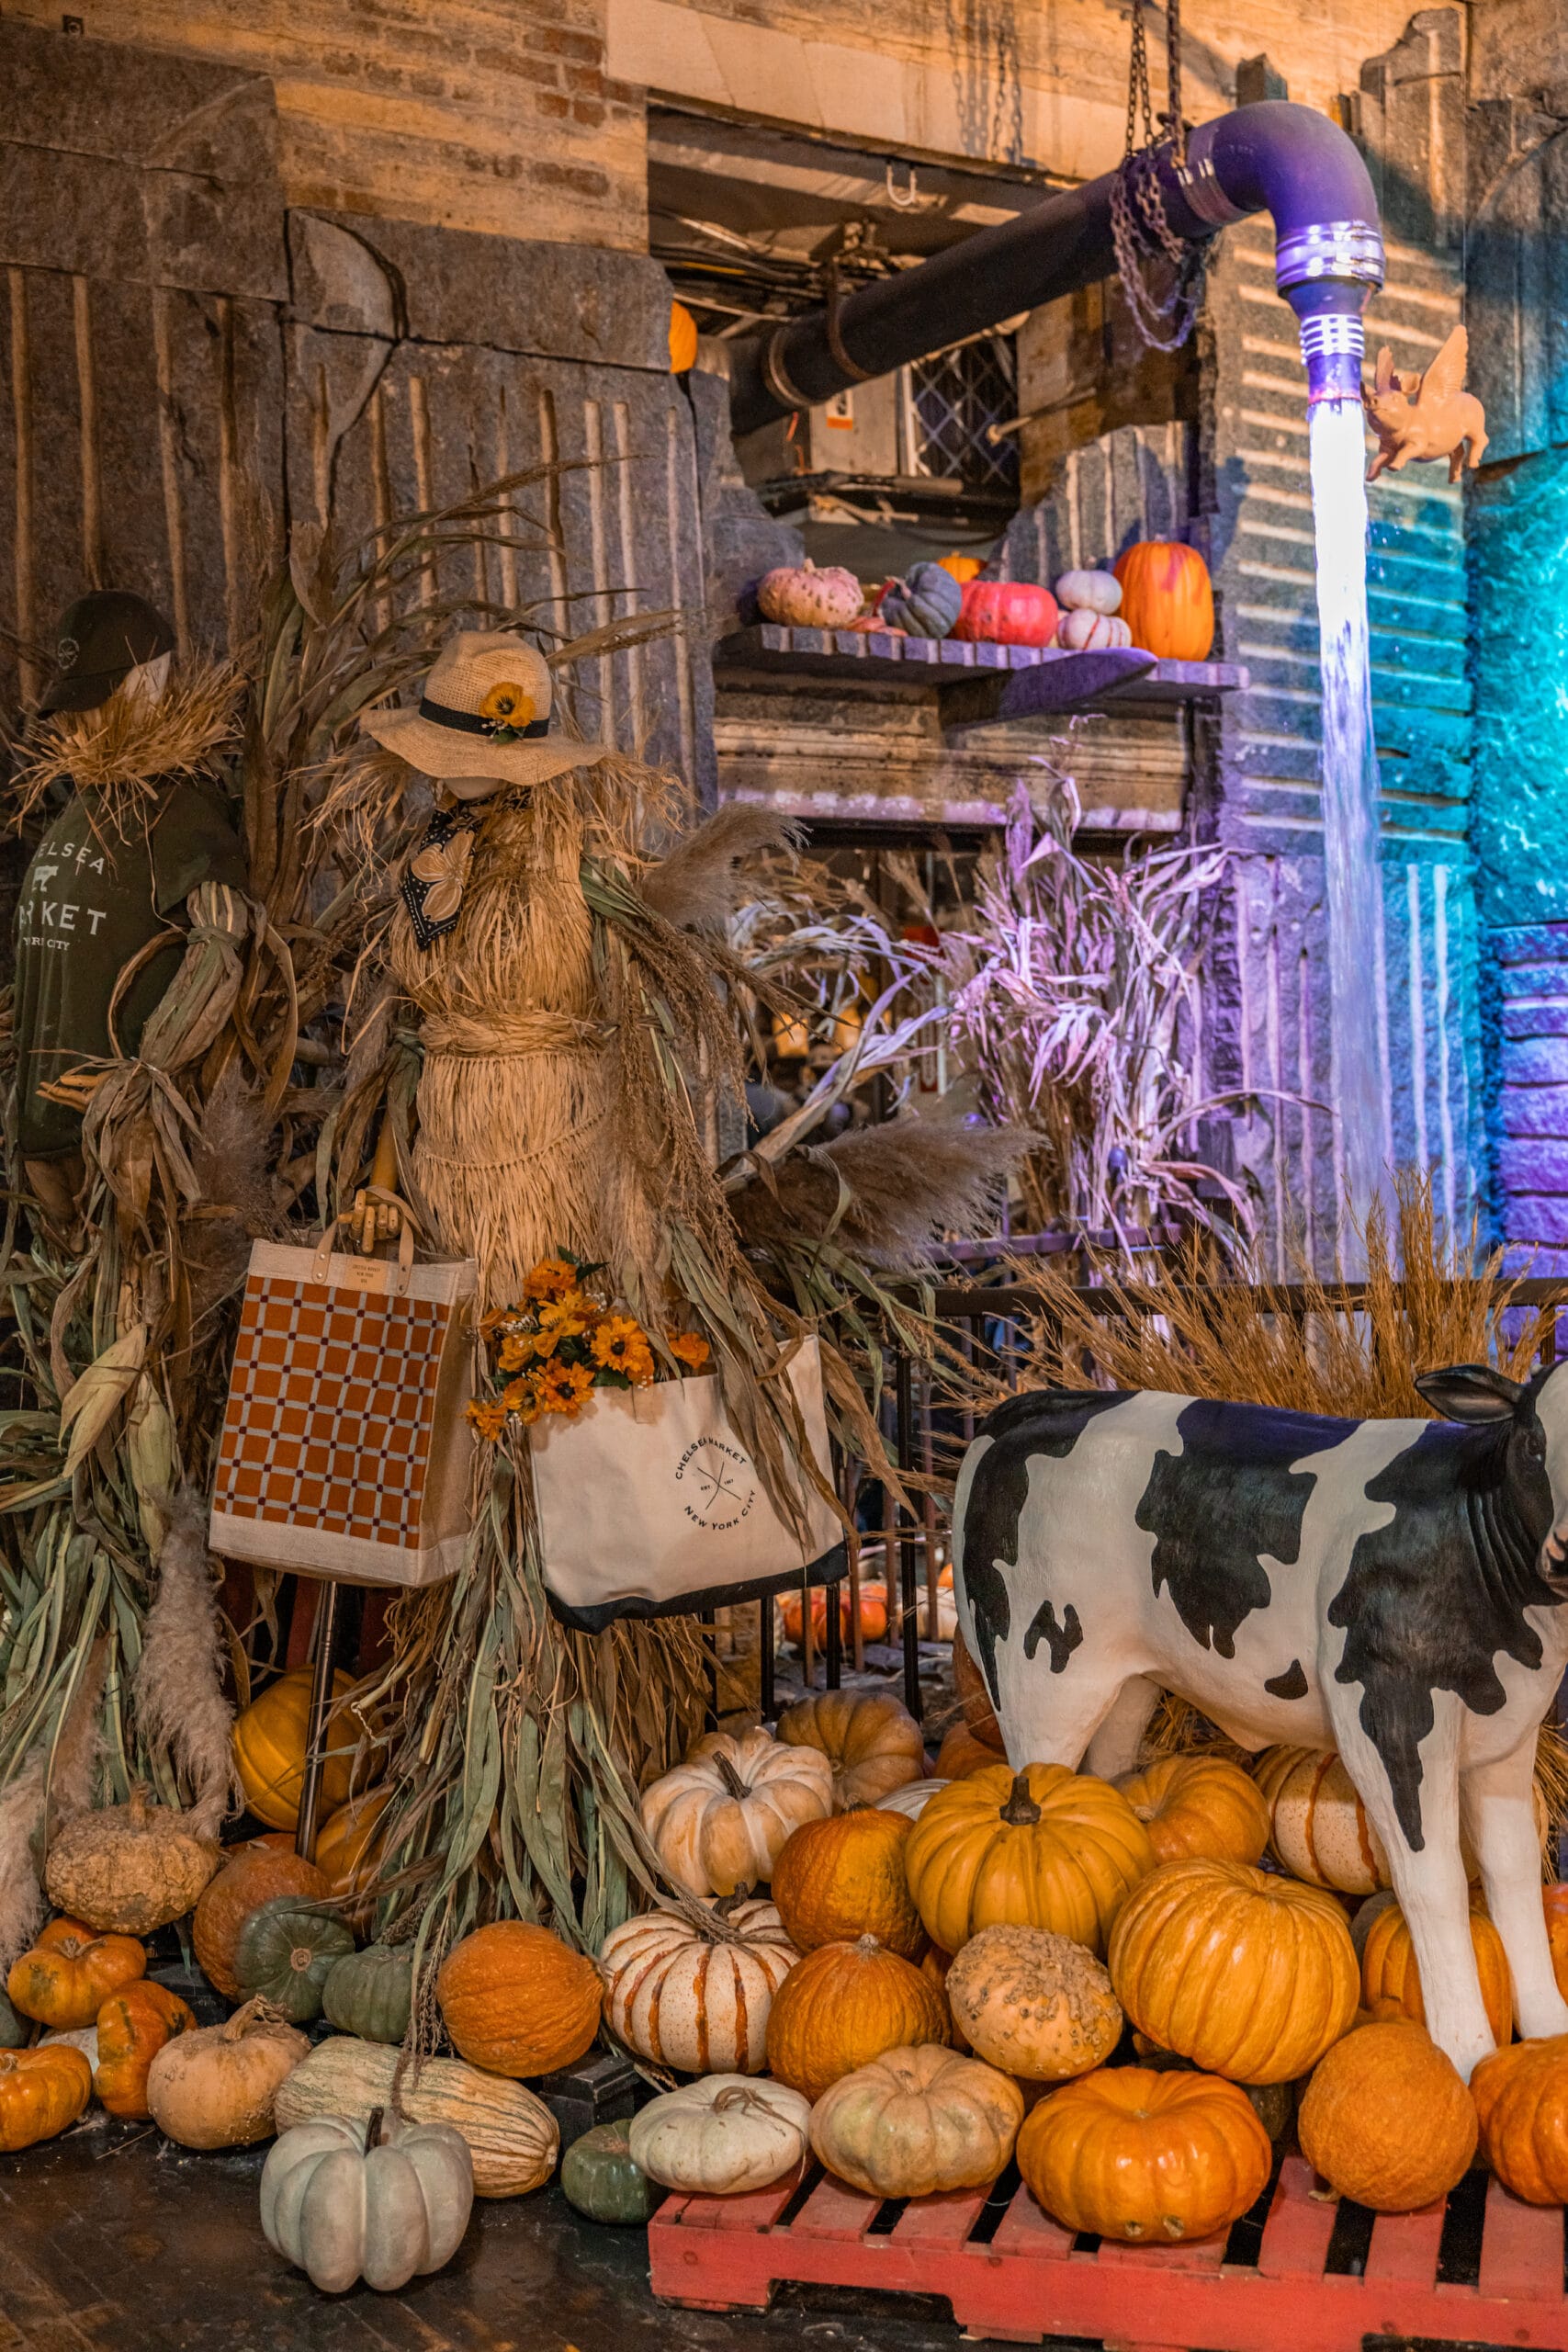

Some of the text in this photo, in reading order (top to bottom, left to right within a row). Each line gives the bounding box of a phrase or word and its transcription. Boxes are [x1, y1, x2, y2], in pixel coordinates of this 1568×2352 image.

[675, 1436, 747, 1480] CHELSEA MARKET
[684, 1489, 756, 1531] NEW YORK CITY
